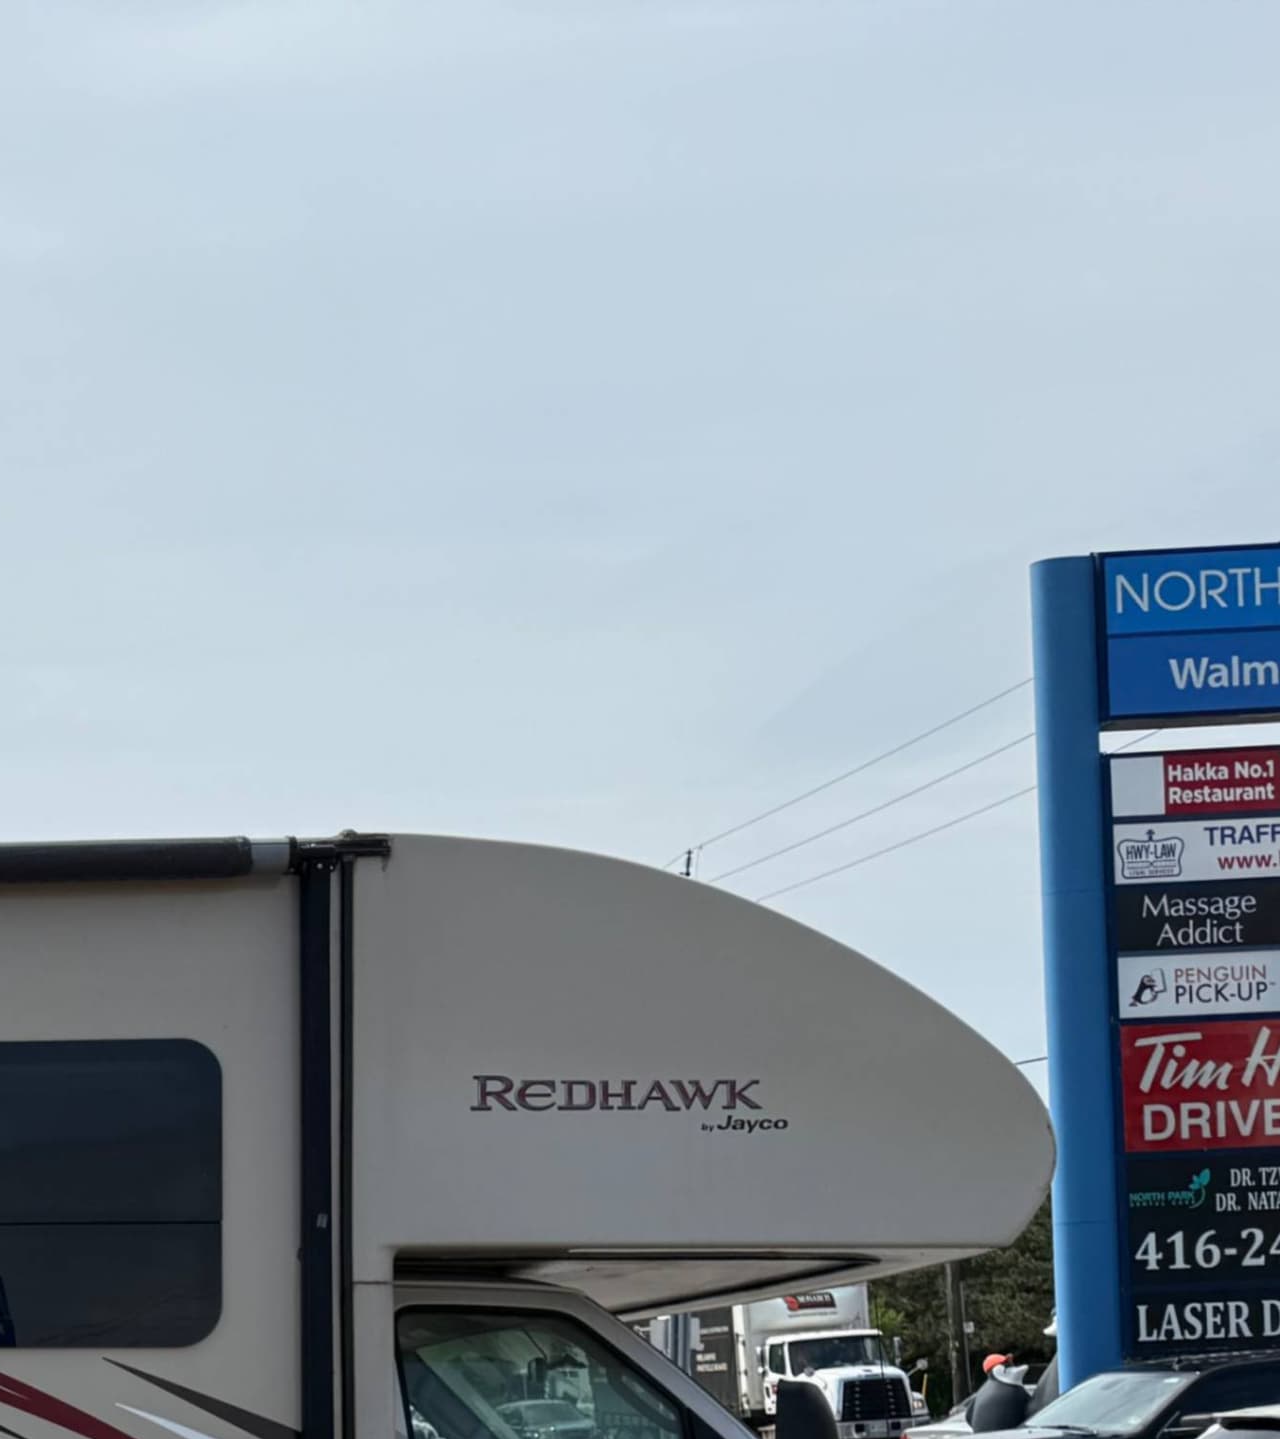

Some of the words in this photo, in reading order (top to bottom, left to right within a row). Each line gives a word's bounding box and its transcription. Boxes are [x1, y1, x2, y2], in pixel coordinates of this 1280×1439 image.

[1115, 566, 1280, 614] NORTH
[1168, 655, 1280, 690] Walm
[1167, 763, 1229, 782] Hakka
[1233, 760, 1275, 779] No.1
[1168, 777, 1275, 805] Restaurant
[1203, 823, 1280, 847] TRAFF
[1125, 842, 1177, 861] HWY-LAW
[1217, 850, 1280, 870] www.
[1141, 894, 1257, 920] Massage
[1156, 920, 1244, 947] Addict
[1174, 964, 1267, 984] PENGUIN
[1175, 981, 1268, 1004] PICK-UP
[1134, 1032, 1233, 1094] Tim
[717, 1114, 789, 1134] Jayco
[1143, 1098, 1280, 1142] DRIVE
[1230, 1167, 1256, 1188] DR.
[1215, 1192, 1242, 1213] DR.
[1137, 1300, 1254, 1342] LASER
